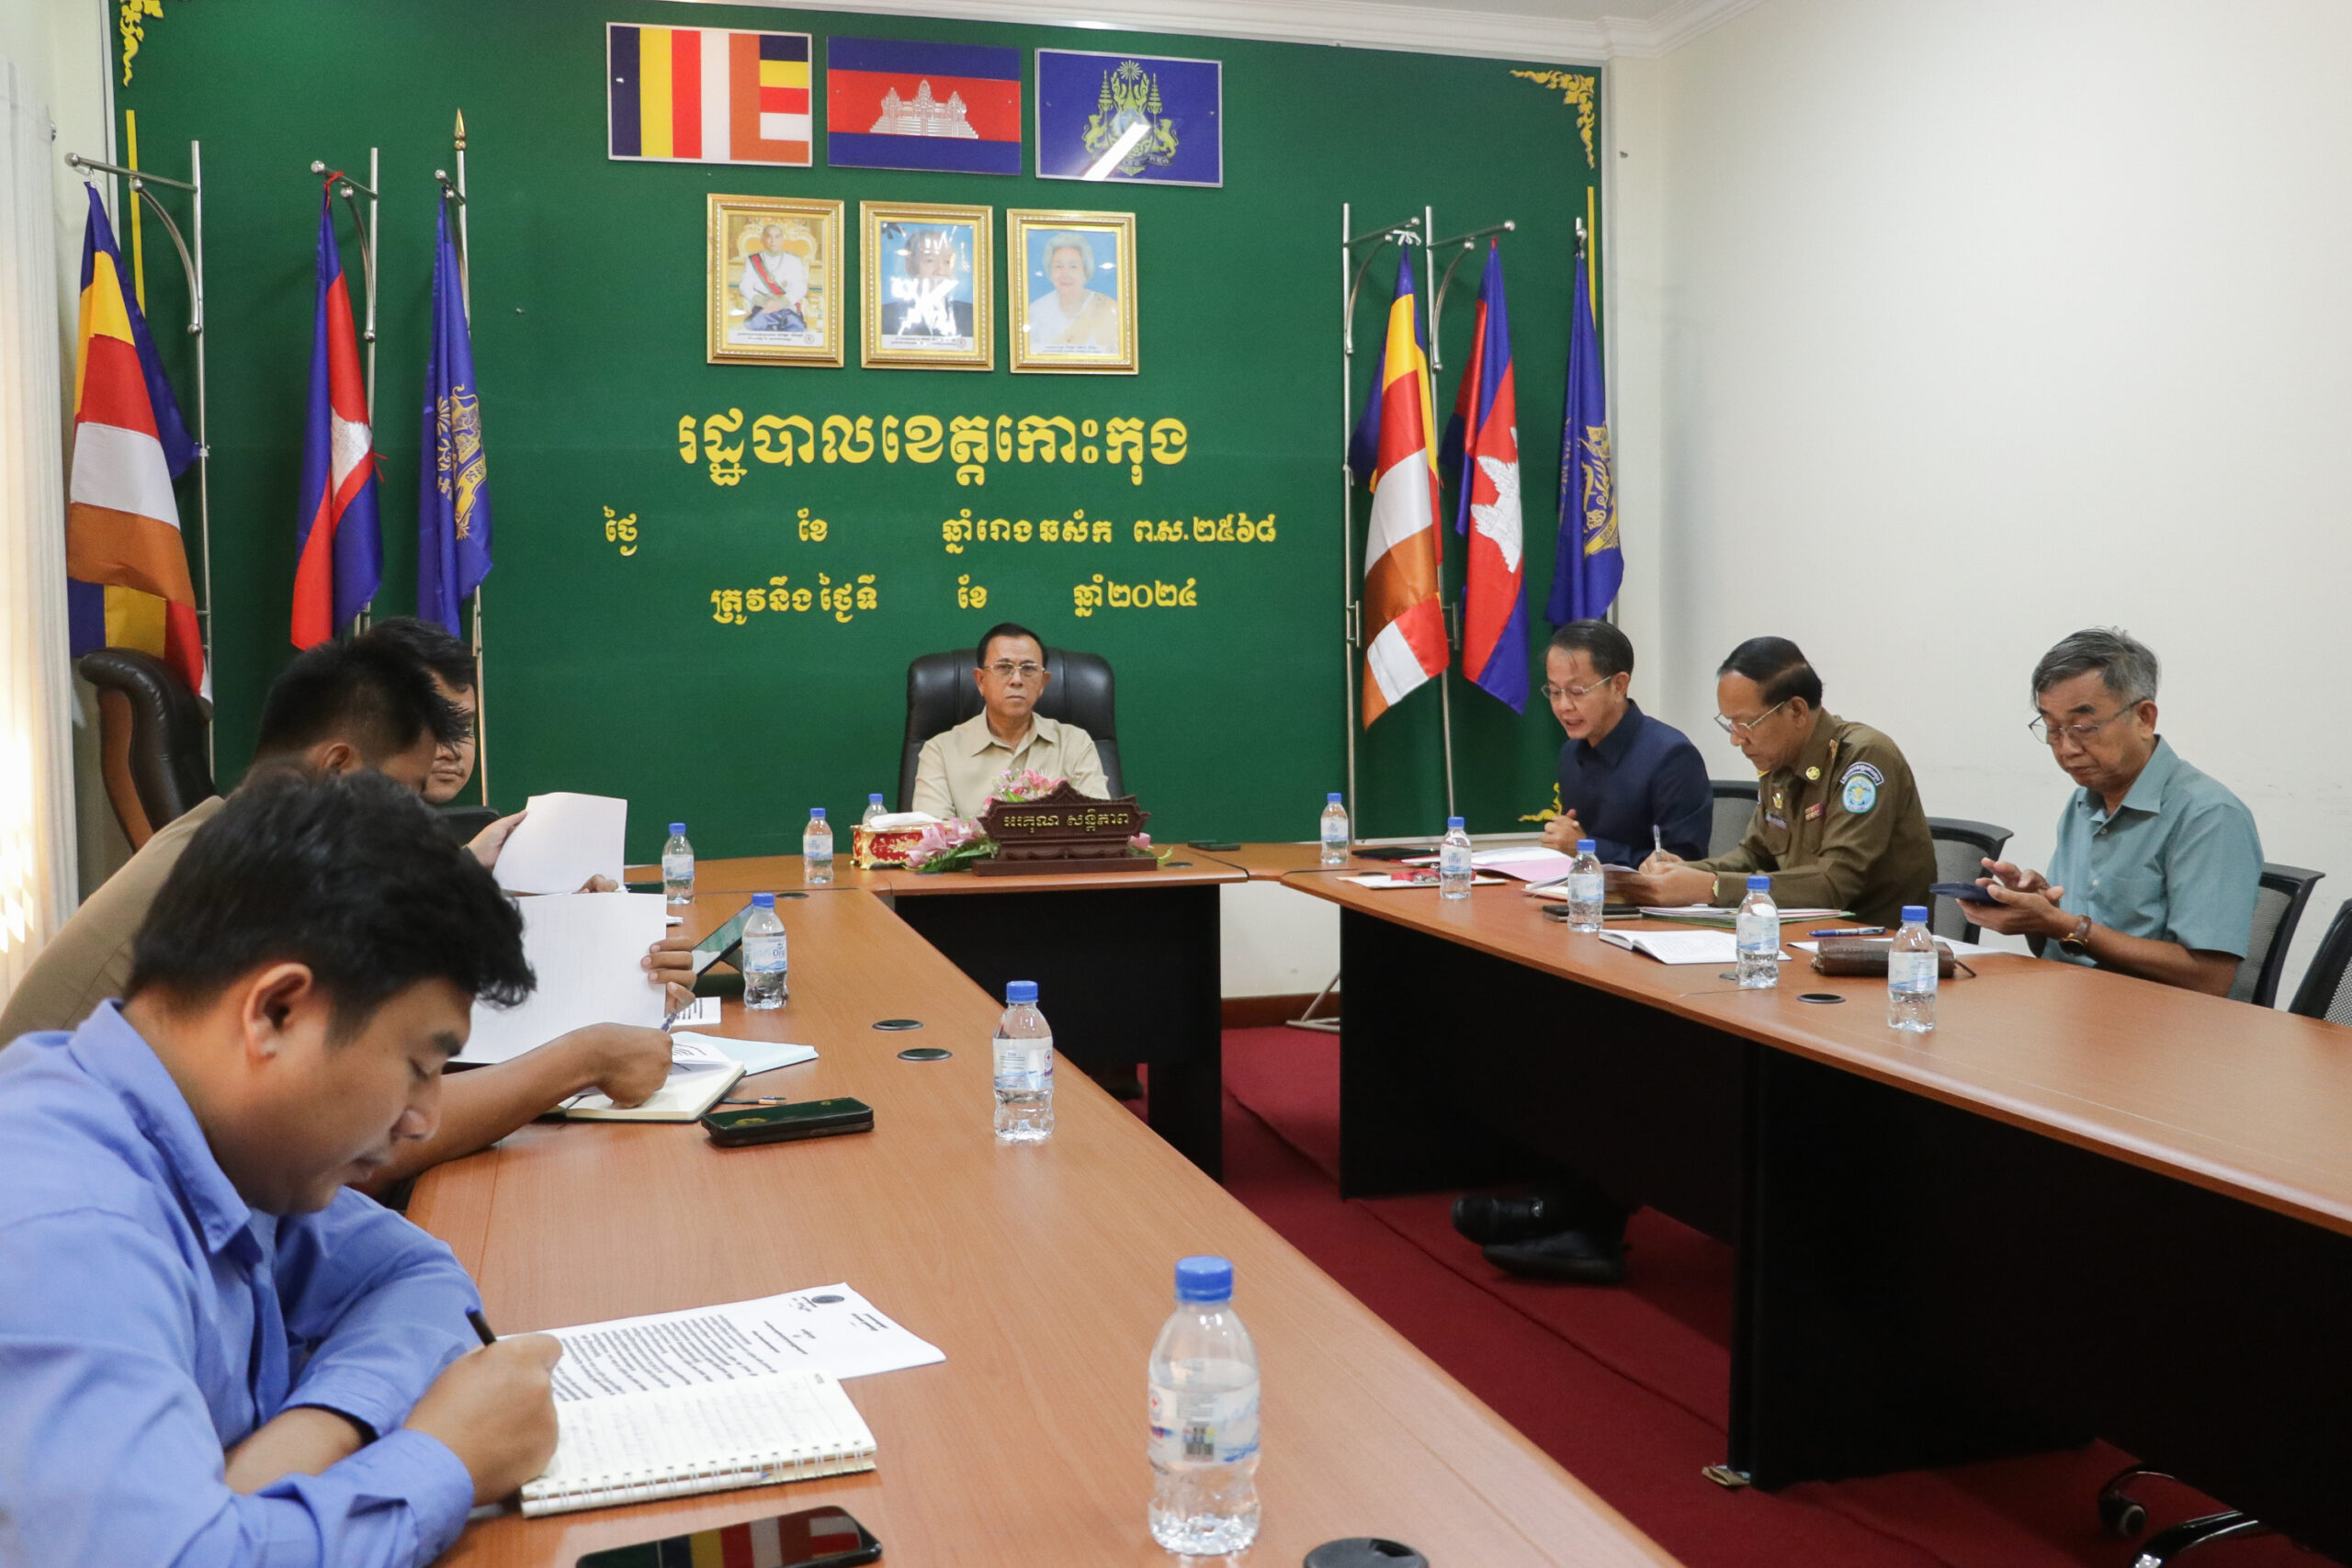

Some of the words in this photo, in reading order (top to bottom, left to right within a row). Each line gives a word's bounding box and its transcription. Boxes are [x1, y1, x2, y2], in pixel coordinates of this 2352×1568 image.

[603, 505, 638, 557] ថ្ងៃ
[797, 507, 828, 542] ខែ
[957, 573, 988, 609] ខែ
